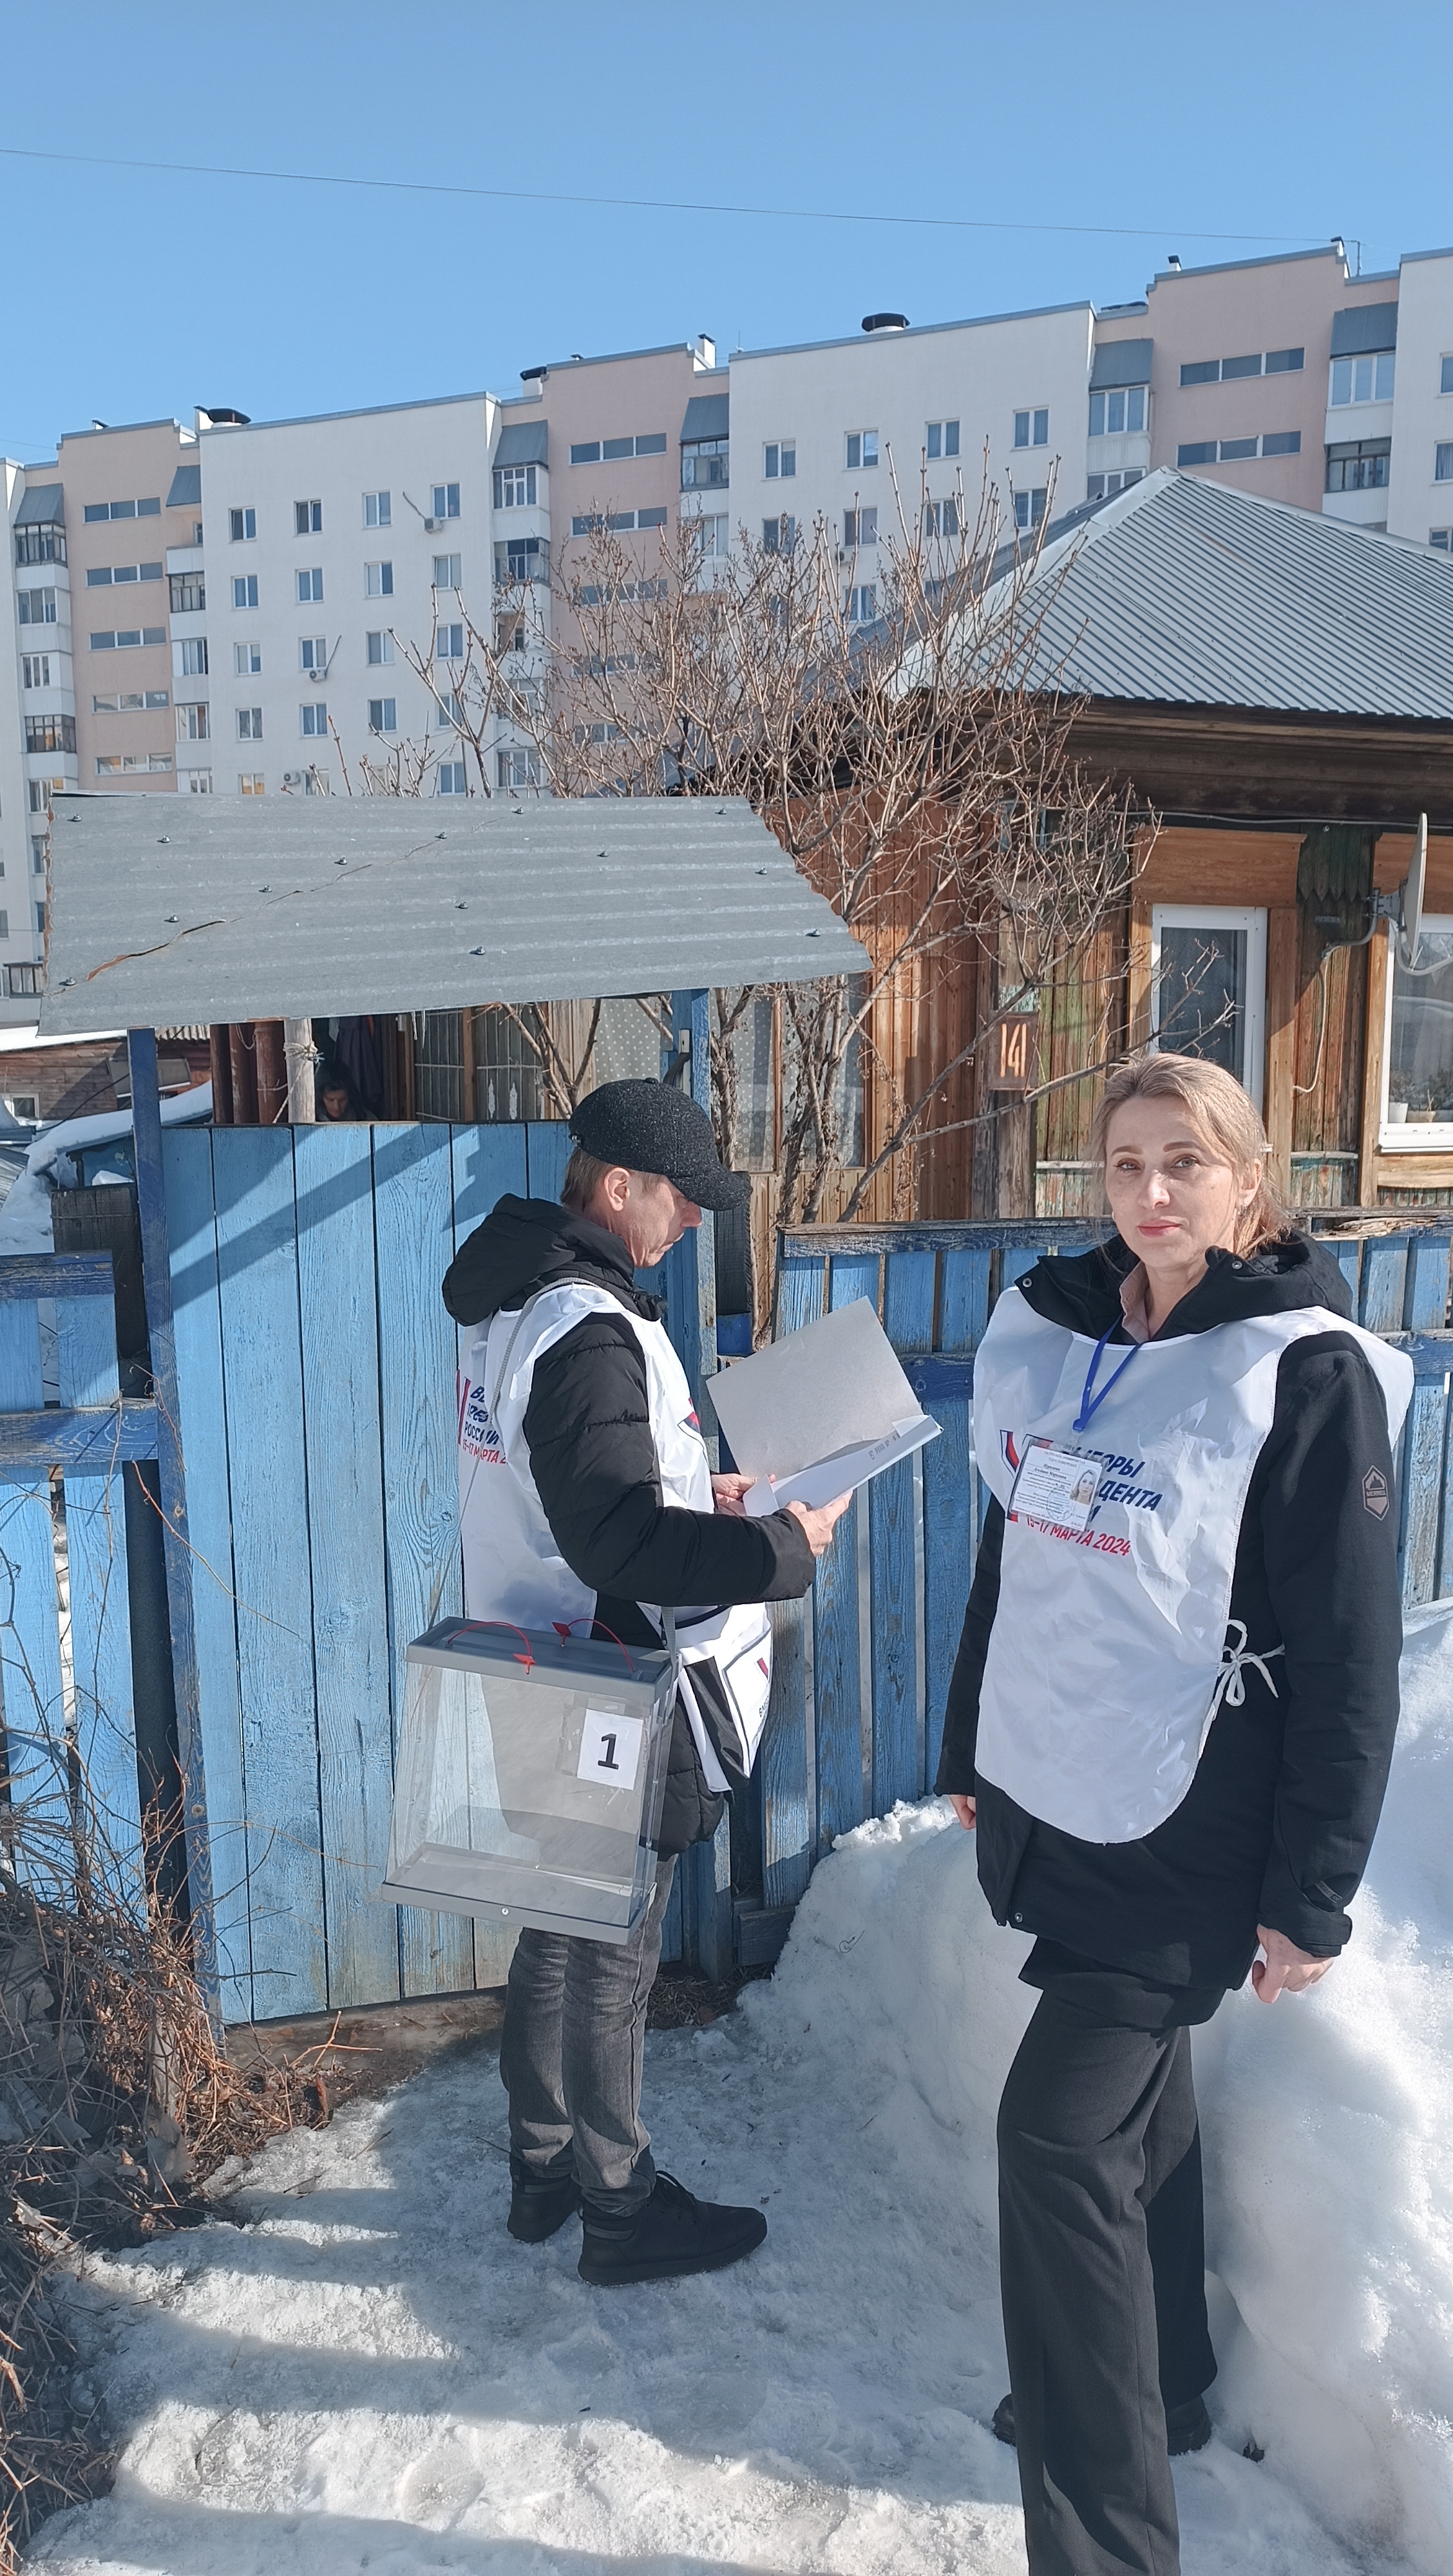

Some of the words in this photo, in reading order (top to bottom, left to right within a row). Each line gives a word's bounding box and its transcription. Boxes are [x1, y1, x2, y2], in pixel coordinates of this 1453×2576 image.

[1000, 1023, 1027, 1077] 141
[474, 1445, 500, 1464] МРТА
[1098, 1480, 1163, 1511] ДЕНТА
[1049, 1524, 1095, 1546] МАРТА
[1092, 1533, 1132, 1557] 2024
[598, 1733, 619, 1770] 1
